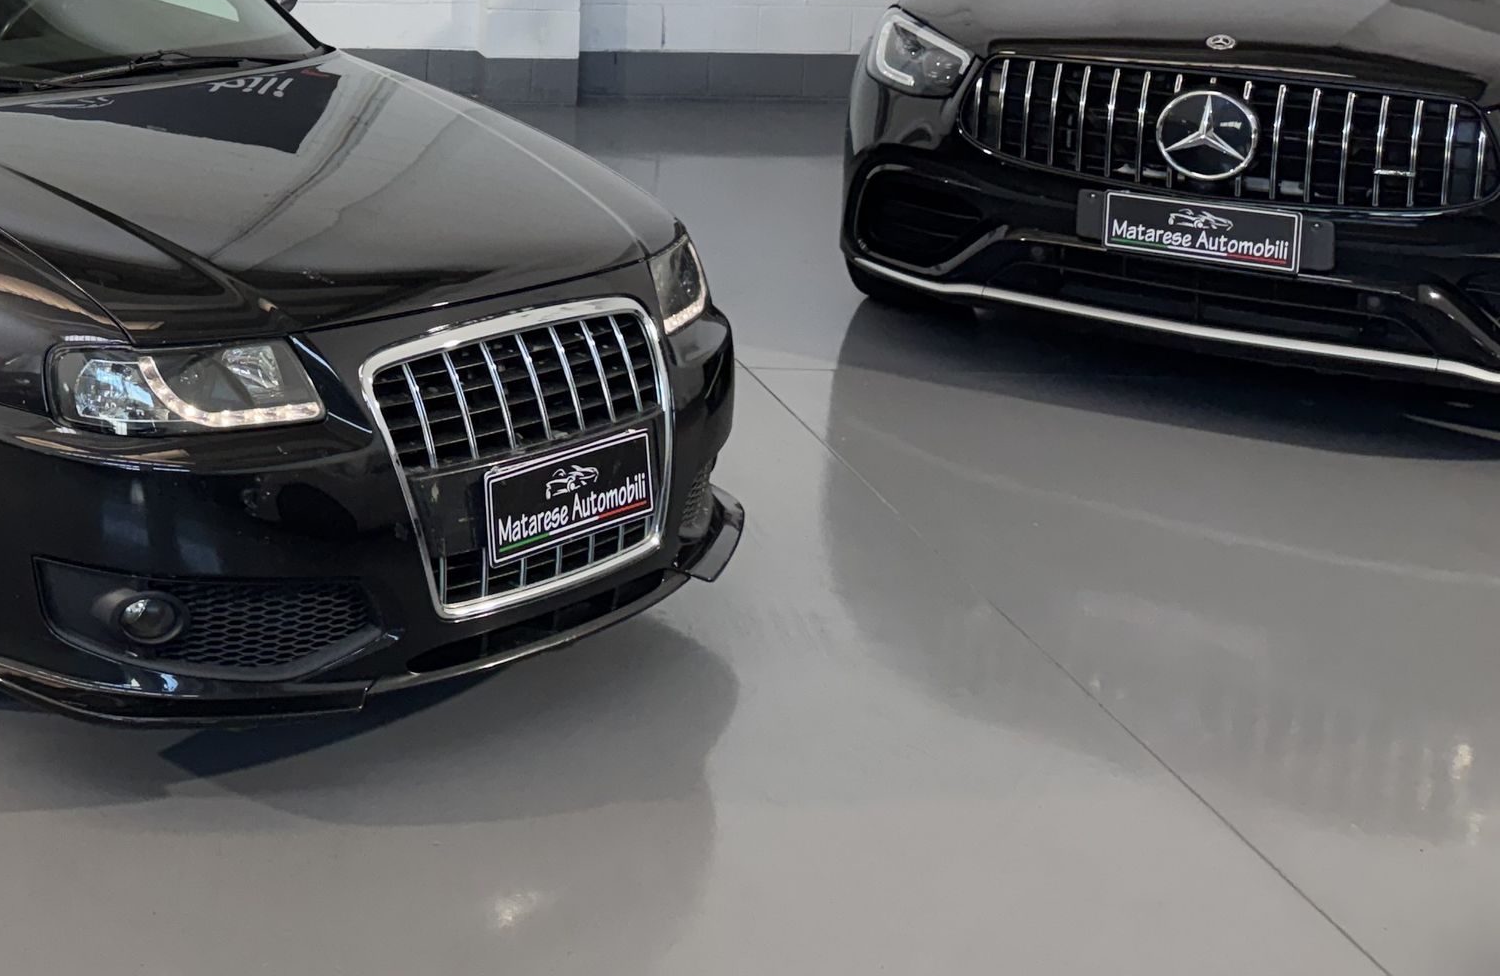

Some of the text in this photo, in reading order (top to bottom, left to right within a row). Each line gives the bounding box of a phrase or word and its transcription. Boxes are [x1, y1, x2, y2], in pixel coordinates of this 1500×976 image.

[1111, 219, 1289, 261] Matarese Automobili
[498, 472, 646, 546] Matarese Automobili
